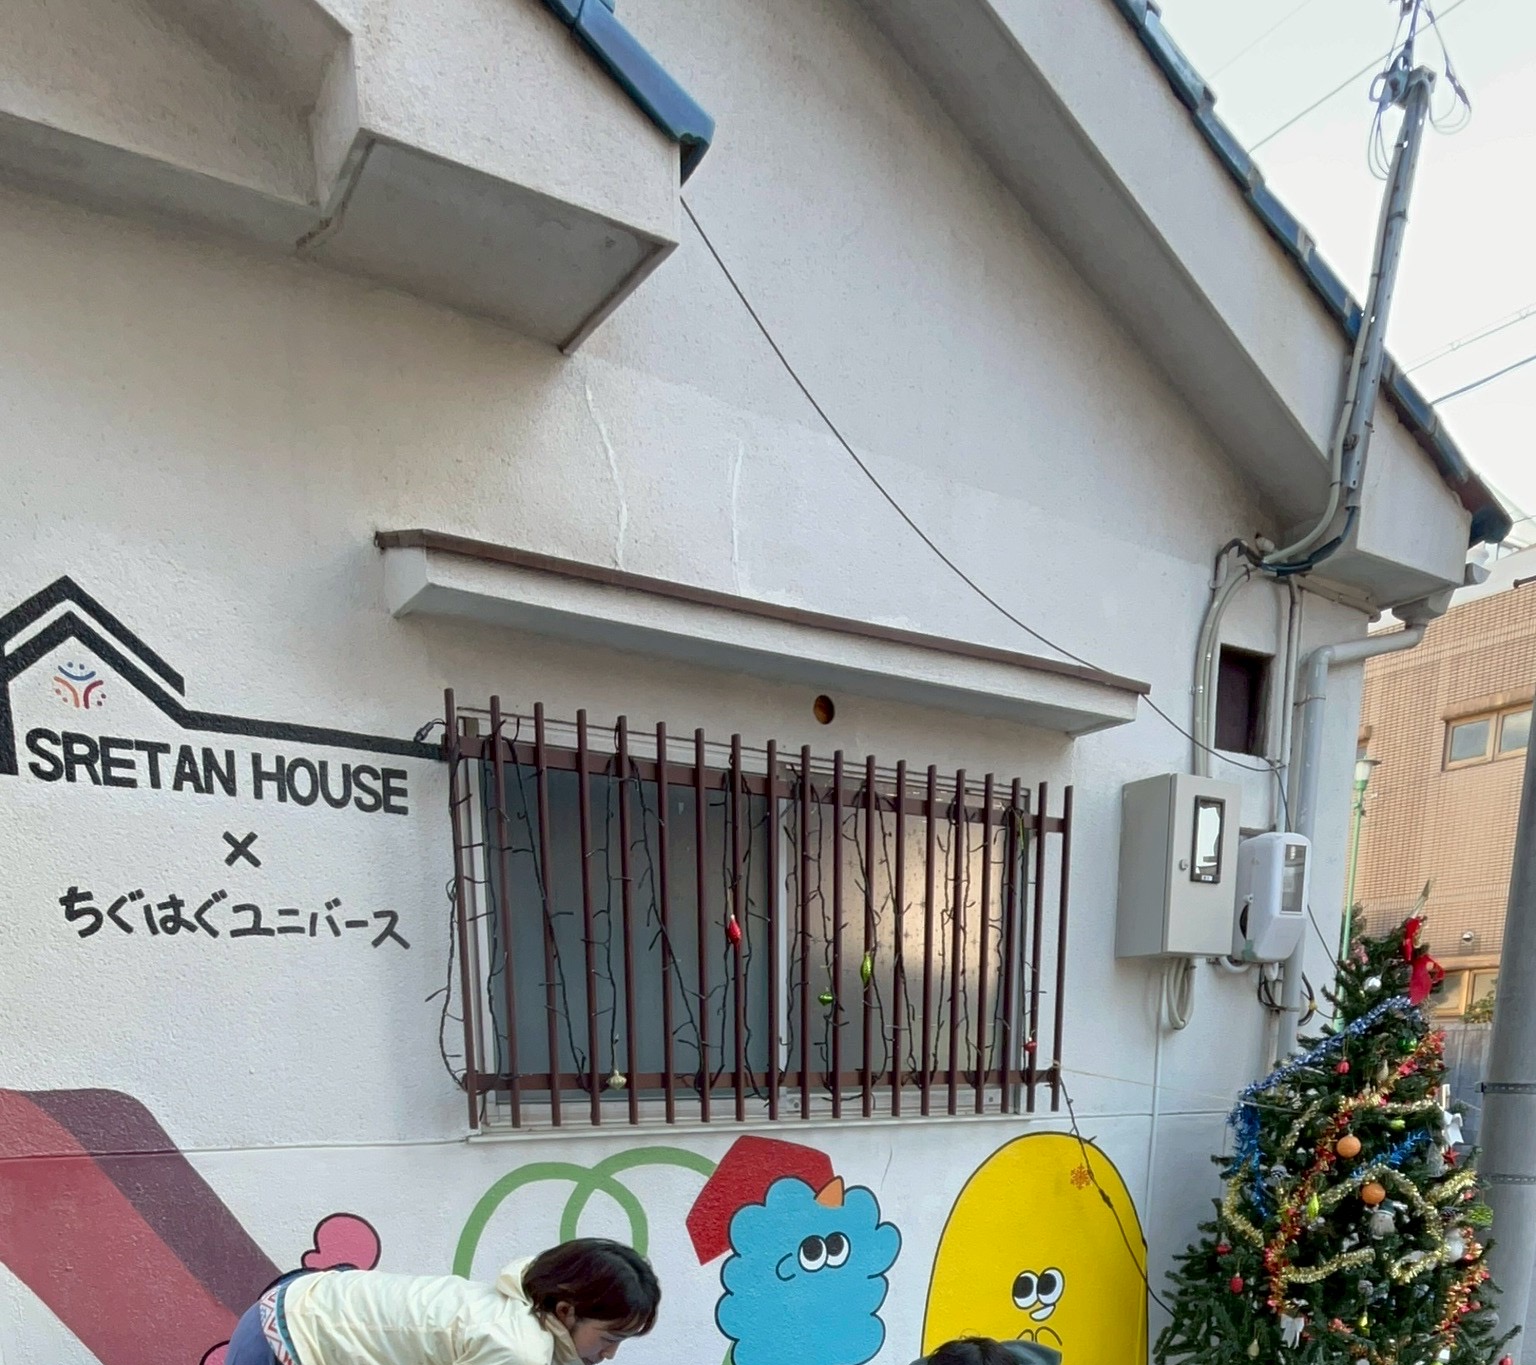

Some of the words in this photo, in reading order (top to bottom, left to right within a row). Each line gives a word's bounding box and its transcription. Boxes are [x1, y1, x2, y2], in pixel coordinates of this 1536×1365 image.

[26, 728, 237, 796] SRETAN
[252, 753, 409, 815] HOUSE
[59, 886, 411, 949] ちぐはぐユニバース
